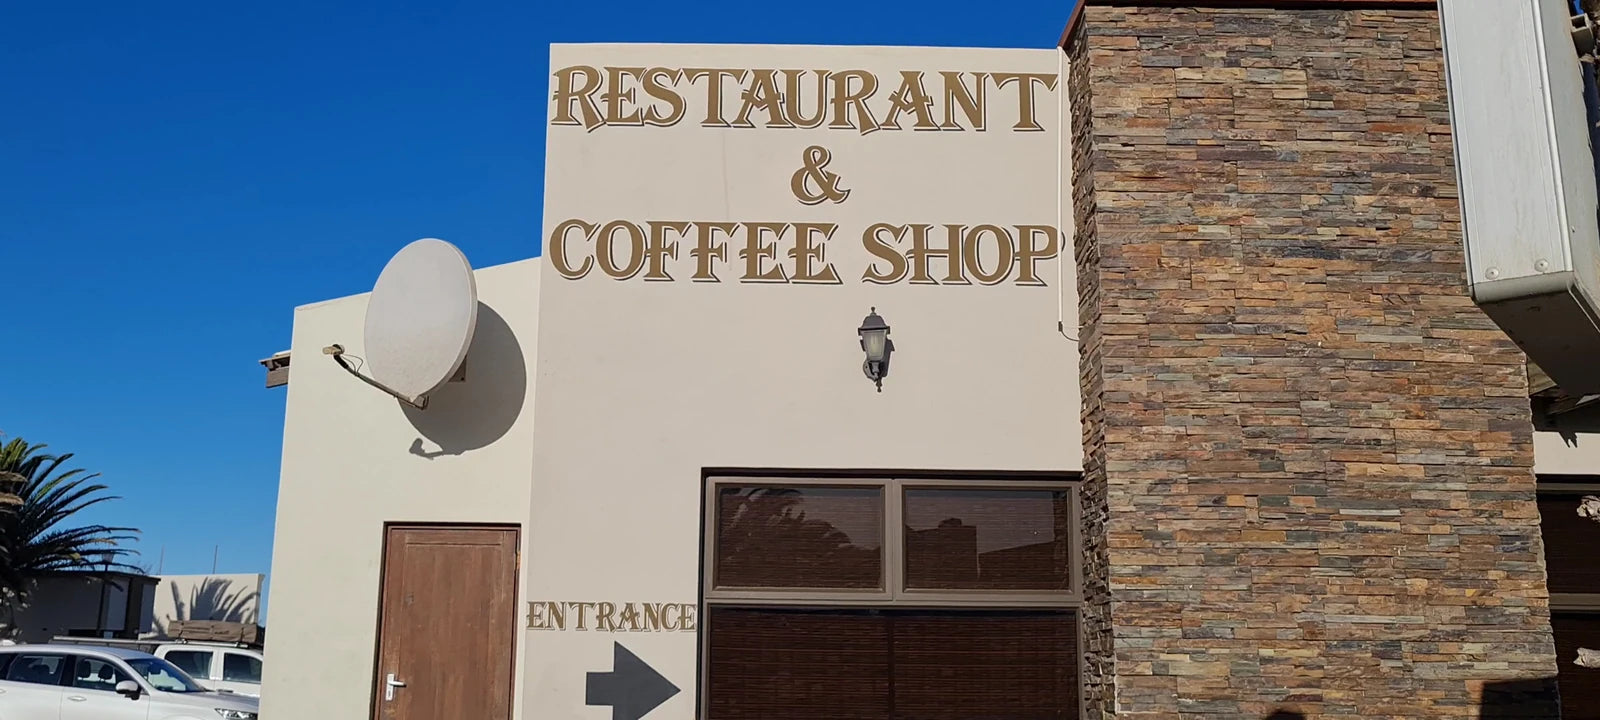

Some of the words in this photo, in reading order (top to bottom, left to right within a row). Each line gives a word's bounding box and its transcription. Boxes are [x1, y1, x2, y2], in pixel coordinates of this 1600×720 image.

[550, 65, 1058, 136] RESTAURANT
[791, 145, 851, 205] &
[549, 219, 843, 285] COFFEE
[861, 223, 1064, 287] SHOP
[526, 601, 697, 633] ENTRANCE
